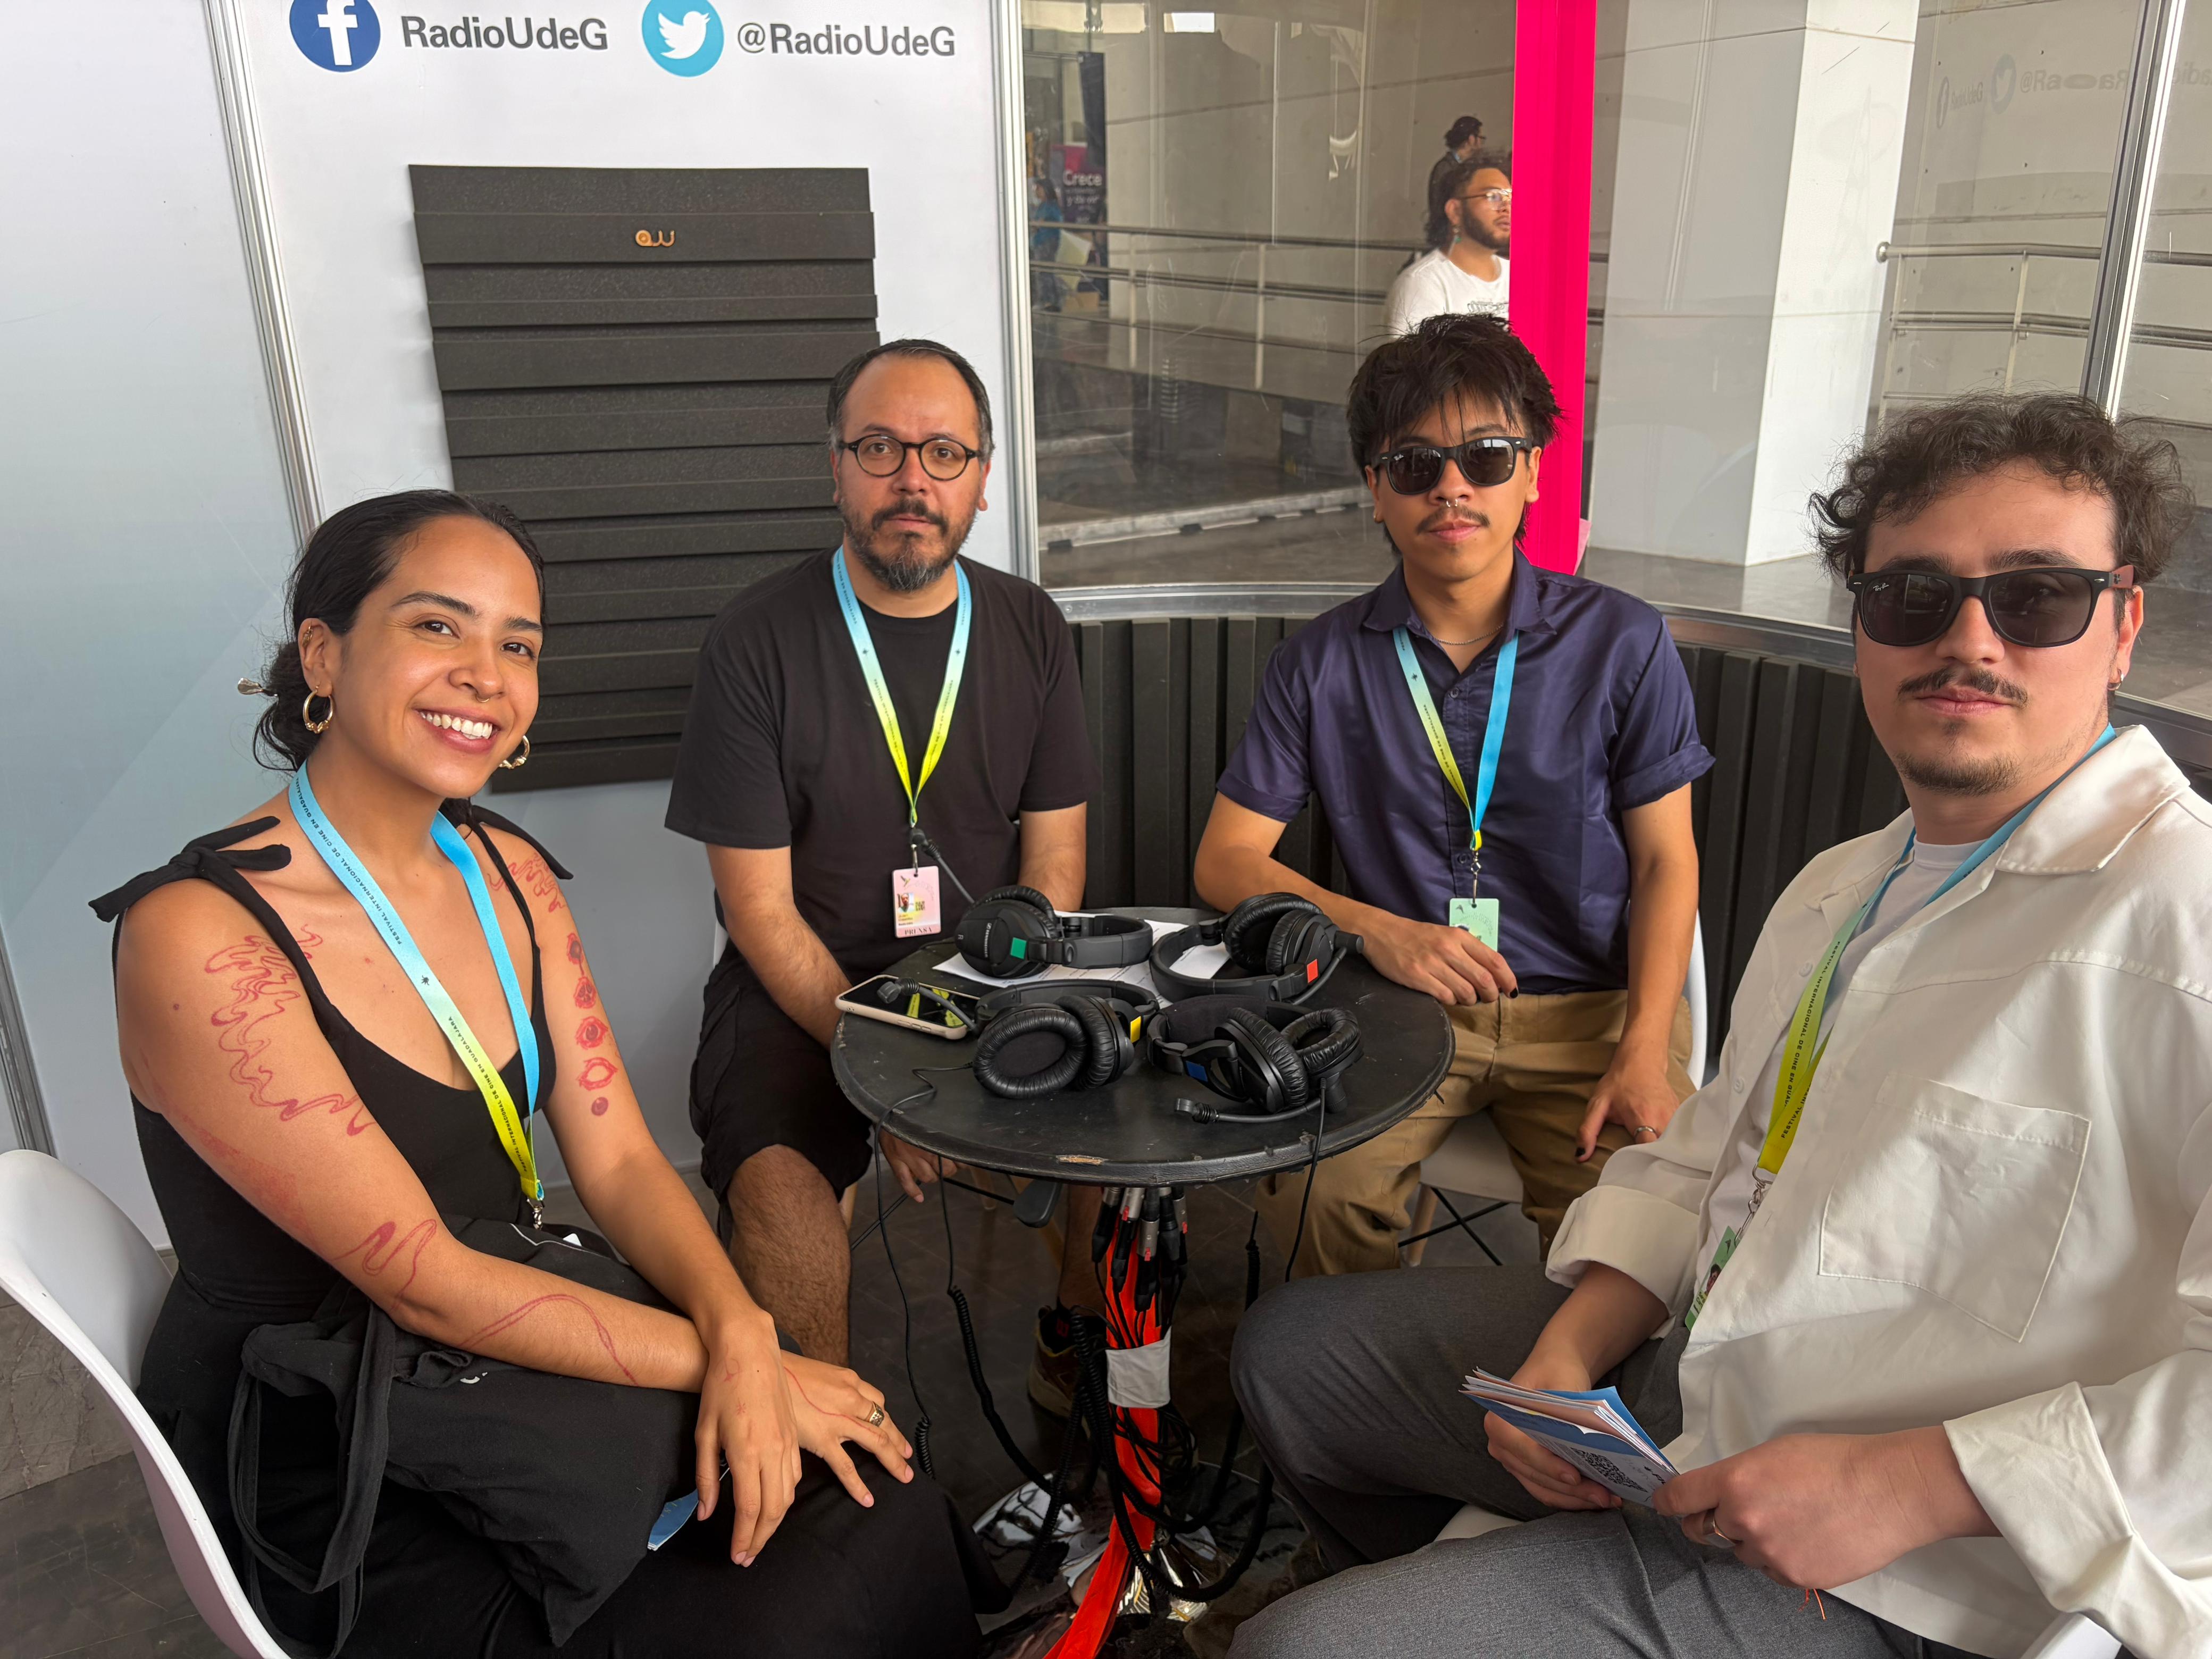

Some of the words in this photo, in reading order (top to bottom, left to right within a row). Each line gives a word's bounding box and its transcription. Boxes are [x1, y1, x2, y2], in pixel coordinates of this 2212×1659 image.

[401, 16, 608, 51] RadioUdeG
[738, 22, 955, 56] @RadioUdeG
[1063, 169, 1102, 186] Crece
[311, 819, 319, 829] EN
[318, 830, 332, 847] CINE
[332, 848, 341, 857] DE
[341, 858, 382, 912] INTERNACIONAL
[382, 912, 403, 945] FESTIVAL
[1821, 941, 1840, 974] FESTIVAL
[1800, 976, 1823, 1038] INTERNACIONAL
[448, 1016, 479, 1063] GUADALAJARA
[1797, 1040, 1804, 1051] DE
[477, 1063, 485, 1073] EN
[1791, 1052, 1800, 1071] CINE
[484, 1074, 494, 1090] CINE
[1789, 1073, 1795, 1083] EN
[492, 1090, 499, 1100] DE
[498, 1100, 517, 1145] INTERNACIONAL
[1781, 1106, 1802, 1138] FESTIVAL
